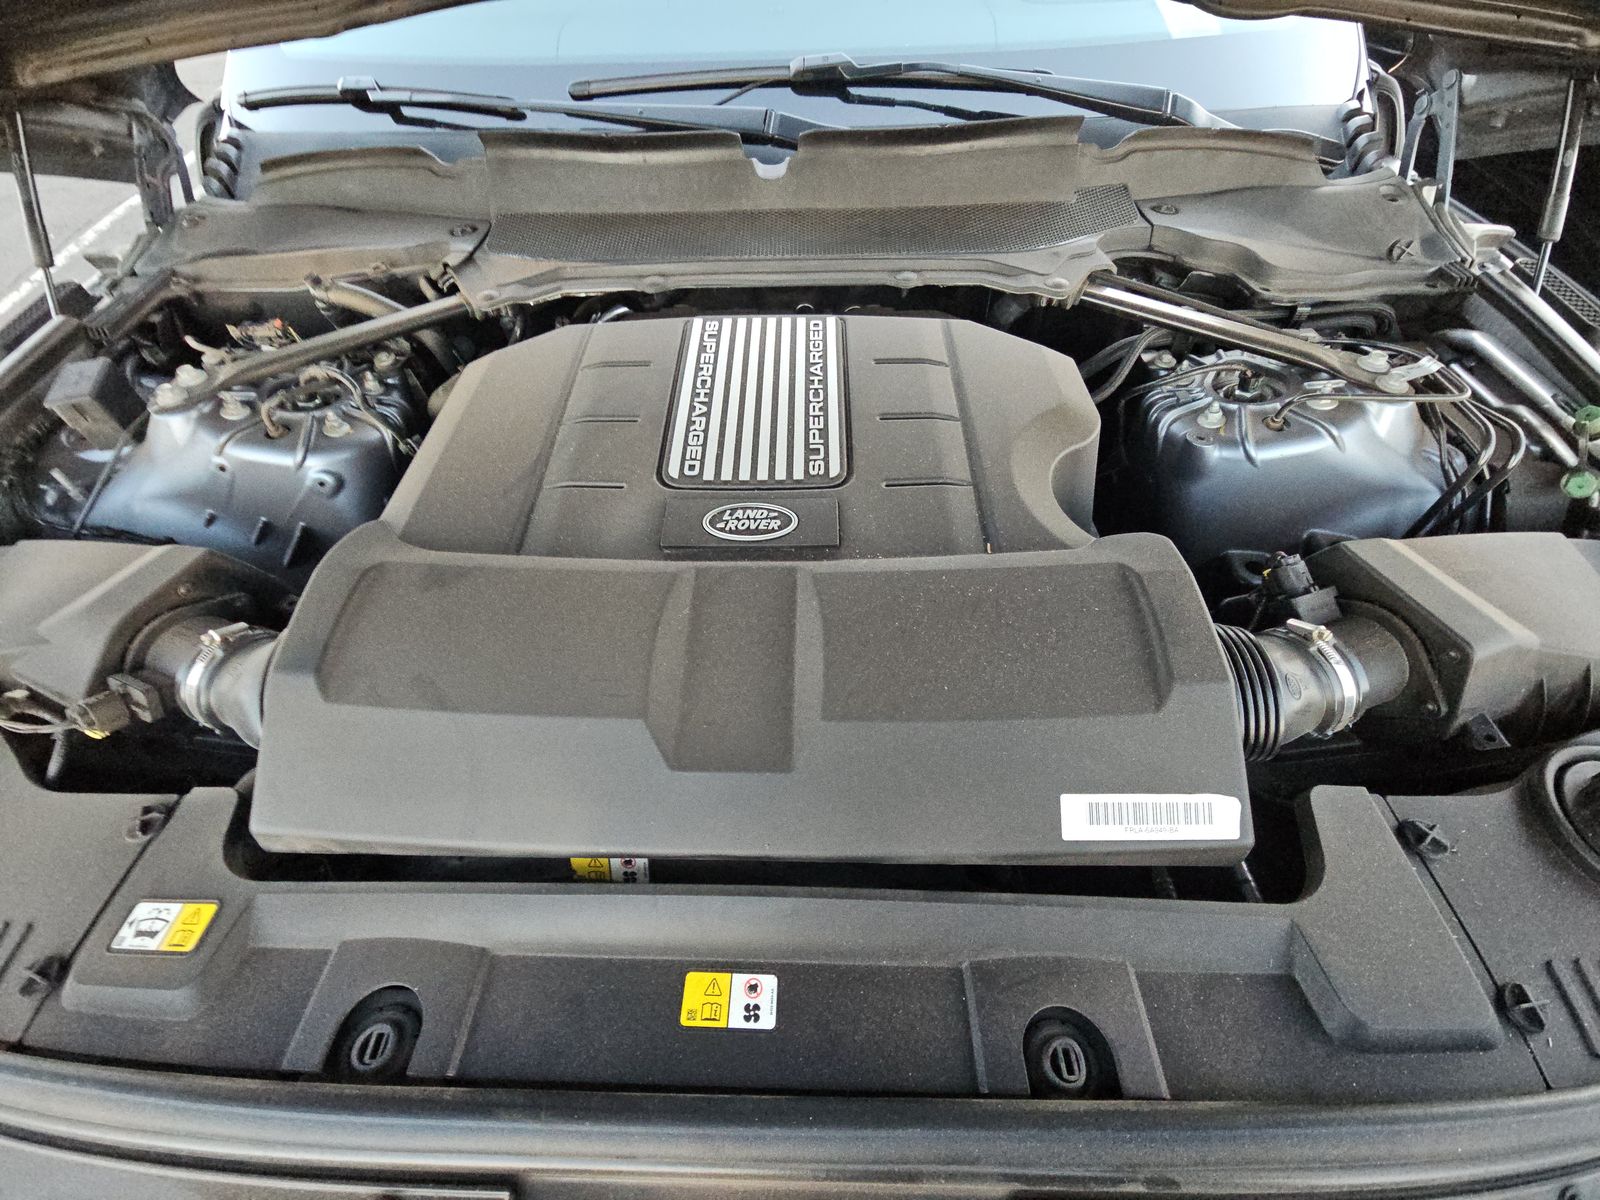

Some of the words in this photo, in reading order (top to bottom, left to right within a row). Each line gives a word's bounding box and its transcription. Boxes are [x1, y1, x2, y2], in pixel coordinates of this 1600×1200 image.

[684, 320, 719, 477] SUPERCHARGED
[808, 319, 825, 476] SUPERCHARGED
[722, 509, 769, 520] LAND
[725, 519, 781, 531] ROVER
